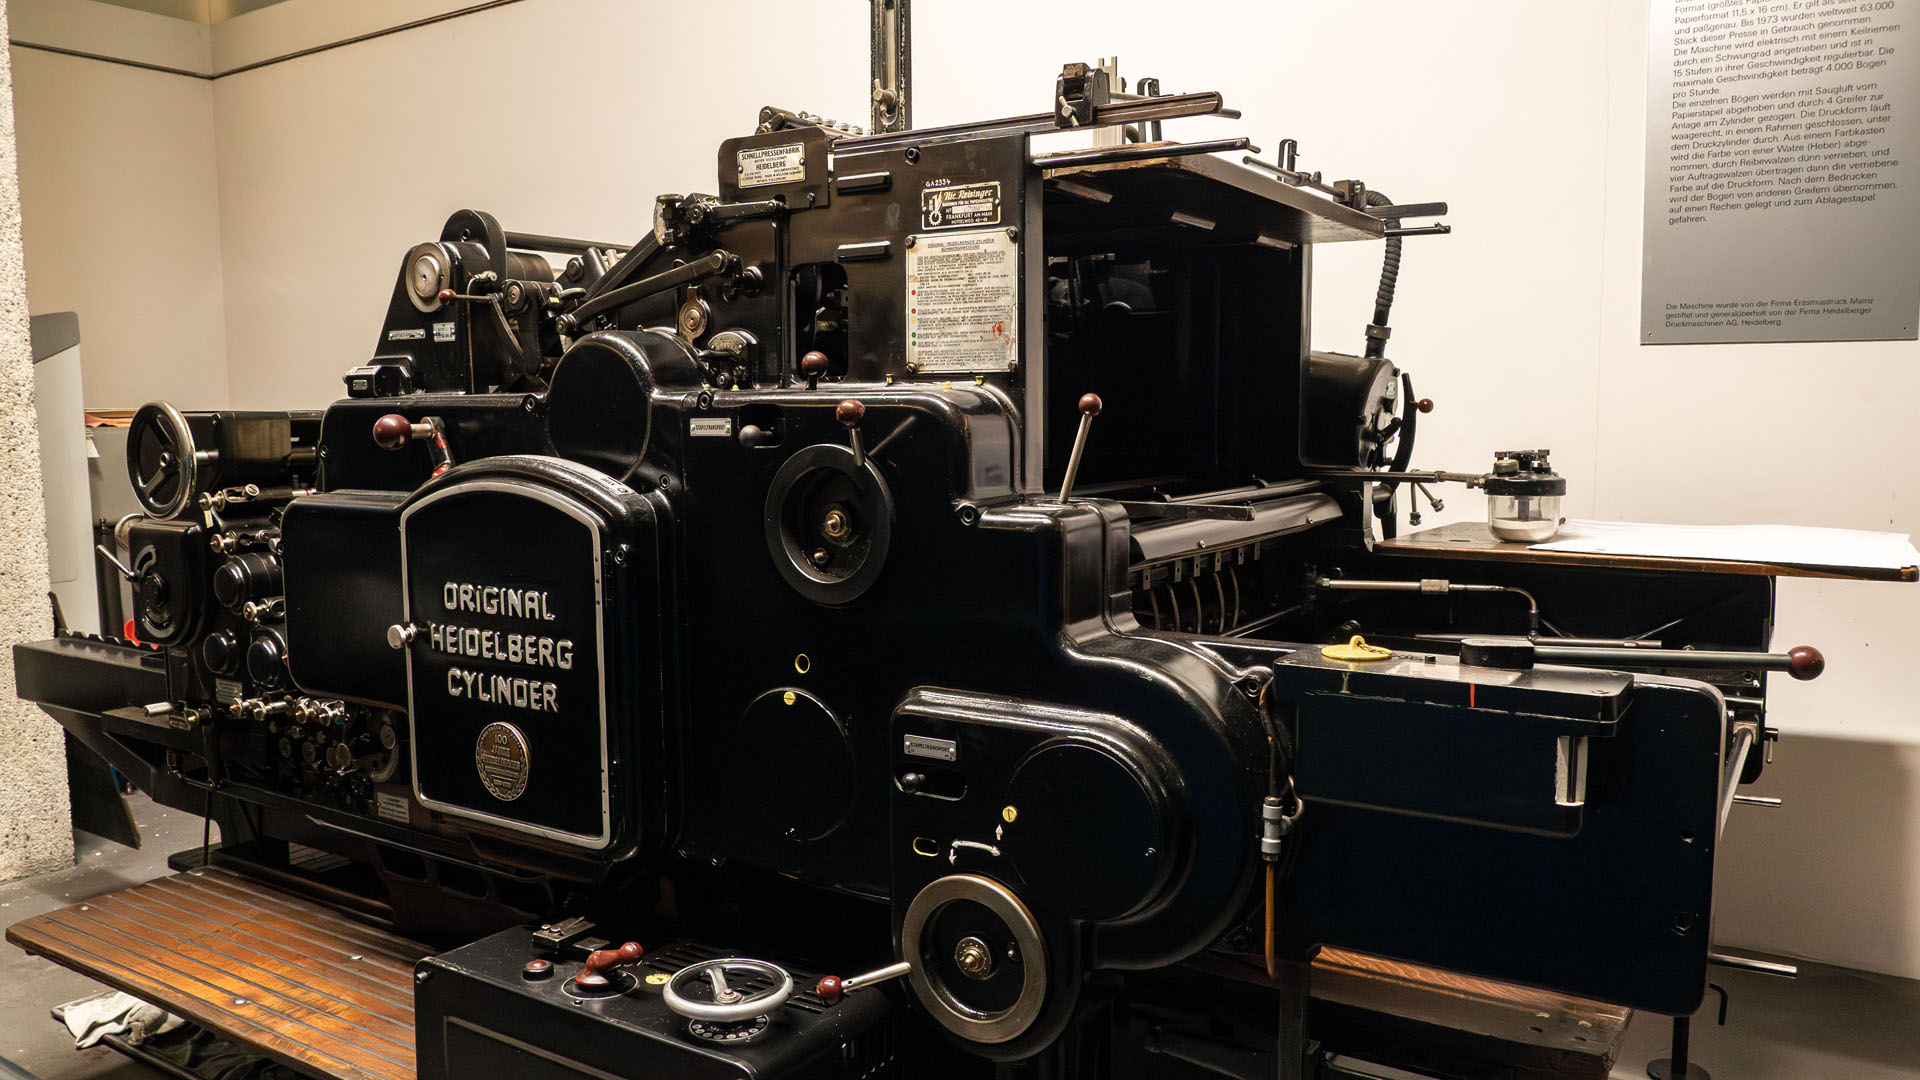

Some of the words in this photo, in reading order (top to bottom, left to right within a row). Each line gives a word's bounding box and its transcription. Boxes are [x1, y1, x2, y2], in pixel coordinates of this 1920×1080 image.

[1676, 4, 1705, 14] Format
[1676, 12, 1729, 24] Papierformat
[1806, 0, 1819, 9] gilt
[1758, 15, 1778, 24] 1973
[1782, 13, 1815, 21] wurden
[1819, 7, 1857, 16] weltweit
[1675, 37, 1697, 45] Stück
[1772, 23, 1815, 34] Gebrauch
[1691, 45, 1732, 54] Maschine
[1757, 36, 1799, 46] elektrisch
[1851, 25, 1900, 35] Keilriemen
[1674, 58, 1698, 66] durch
[1716, 50, 1771, 62] Schwungrad
[1774, 45, 1827, 56] angetrieben
[1831, 41, 1848, 49] und
[1673, 78, 1714, 87] maximale
[1717, 71, 1788, 83] Geschwindigkeit
[1792, 67, 1823, 75] beträgt
[1826, 62, 1853, 71] 4.000
[1857, 61, 1886, 69] Bogen
[1686, 68, 1712, 76] Stufen
[1748, 56, 1821, 69] Geschwindigkeit
[1689, 98, 1728, 107] einzelnen
[1762, 92, 1795, 100] werden
[1816, 85, 1853, 95] Saugluft
[1673, 108, 1723, 119] Papierstapel
[1726, 105, 1775, 114] abgehoben
[1798, 99, 1824, 107] durch
[1836, 95, 1867, 104] Greifer
[1720, 117, 1755, 126] Zylinder
[1819, 107, 1867, 116] Druckform
[1871, 103, 1890, 111] läuft
[1672, 130, 1722, 140] waagerecht,
[1805, 119, 1863, 130] geschlossen,
[1693, 139, 1750, 149] Druckzylinder
[1835, 128, 1885, 136] Farbkasten
[742, 147, 800, 160] SCHNELLPRESSENFABRIK
[1740, 157, 1795, 166] Reibewalzen
[1872, 148, 1889, 156] und
[1807, 142, 1841, 151] (Heber)
[756, 160, 786, 170] HEIDELBERG
[1688, 171, 1752, 180] Auftragswalzen
[1850, 161, 1898, 169] verriebene
[1828, 173, 1877, 181] Bedrucken
[957, 190, 993, 199] Reisinger
[1745, 201, 1771, 210] gelegt
[1815, 195, 1875, 204] Ablagestapel
[444, 582, 556, 620] ORIGINAL
[430, 624, 574, 670] HEIDELBERG
[448, 667, 560, 713] CYLINDER
[494, 734, 508, 745] 100
